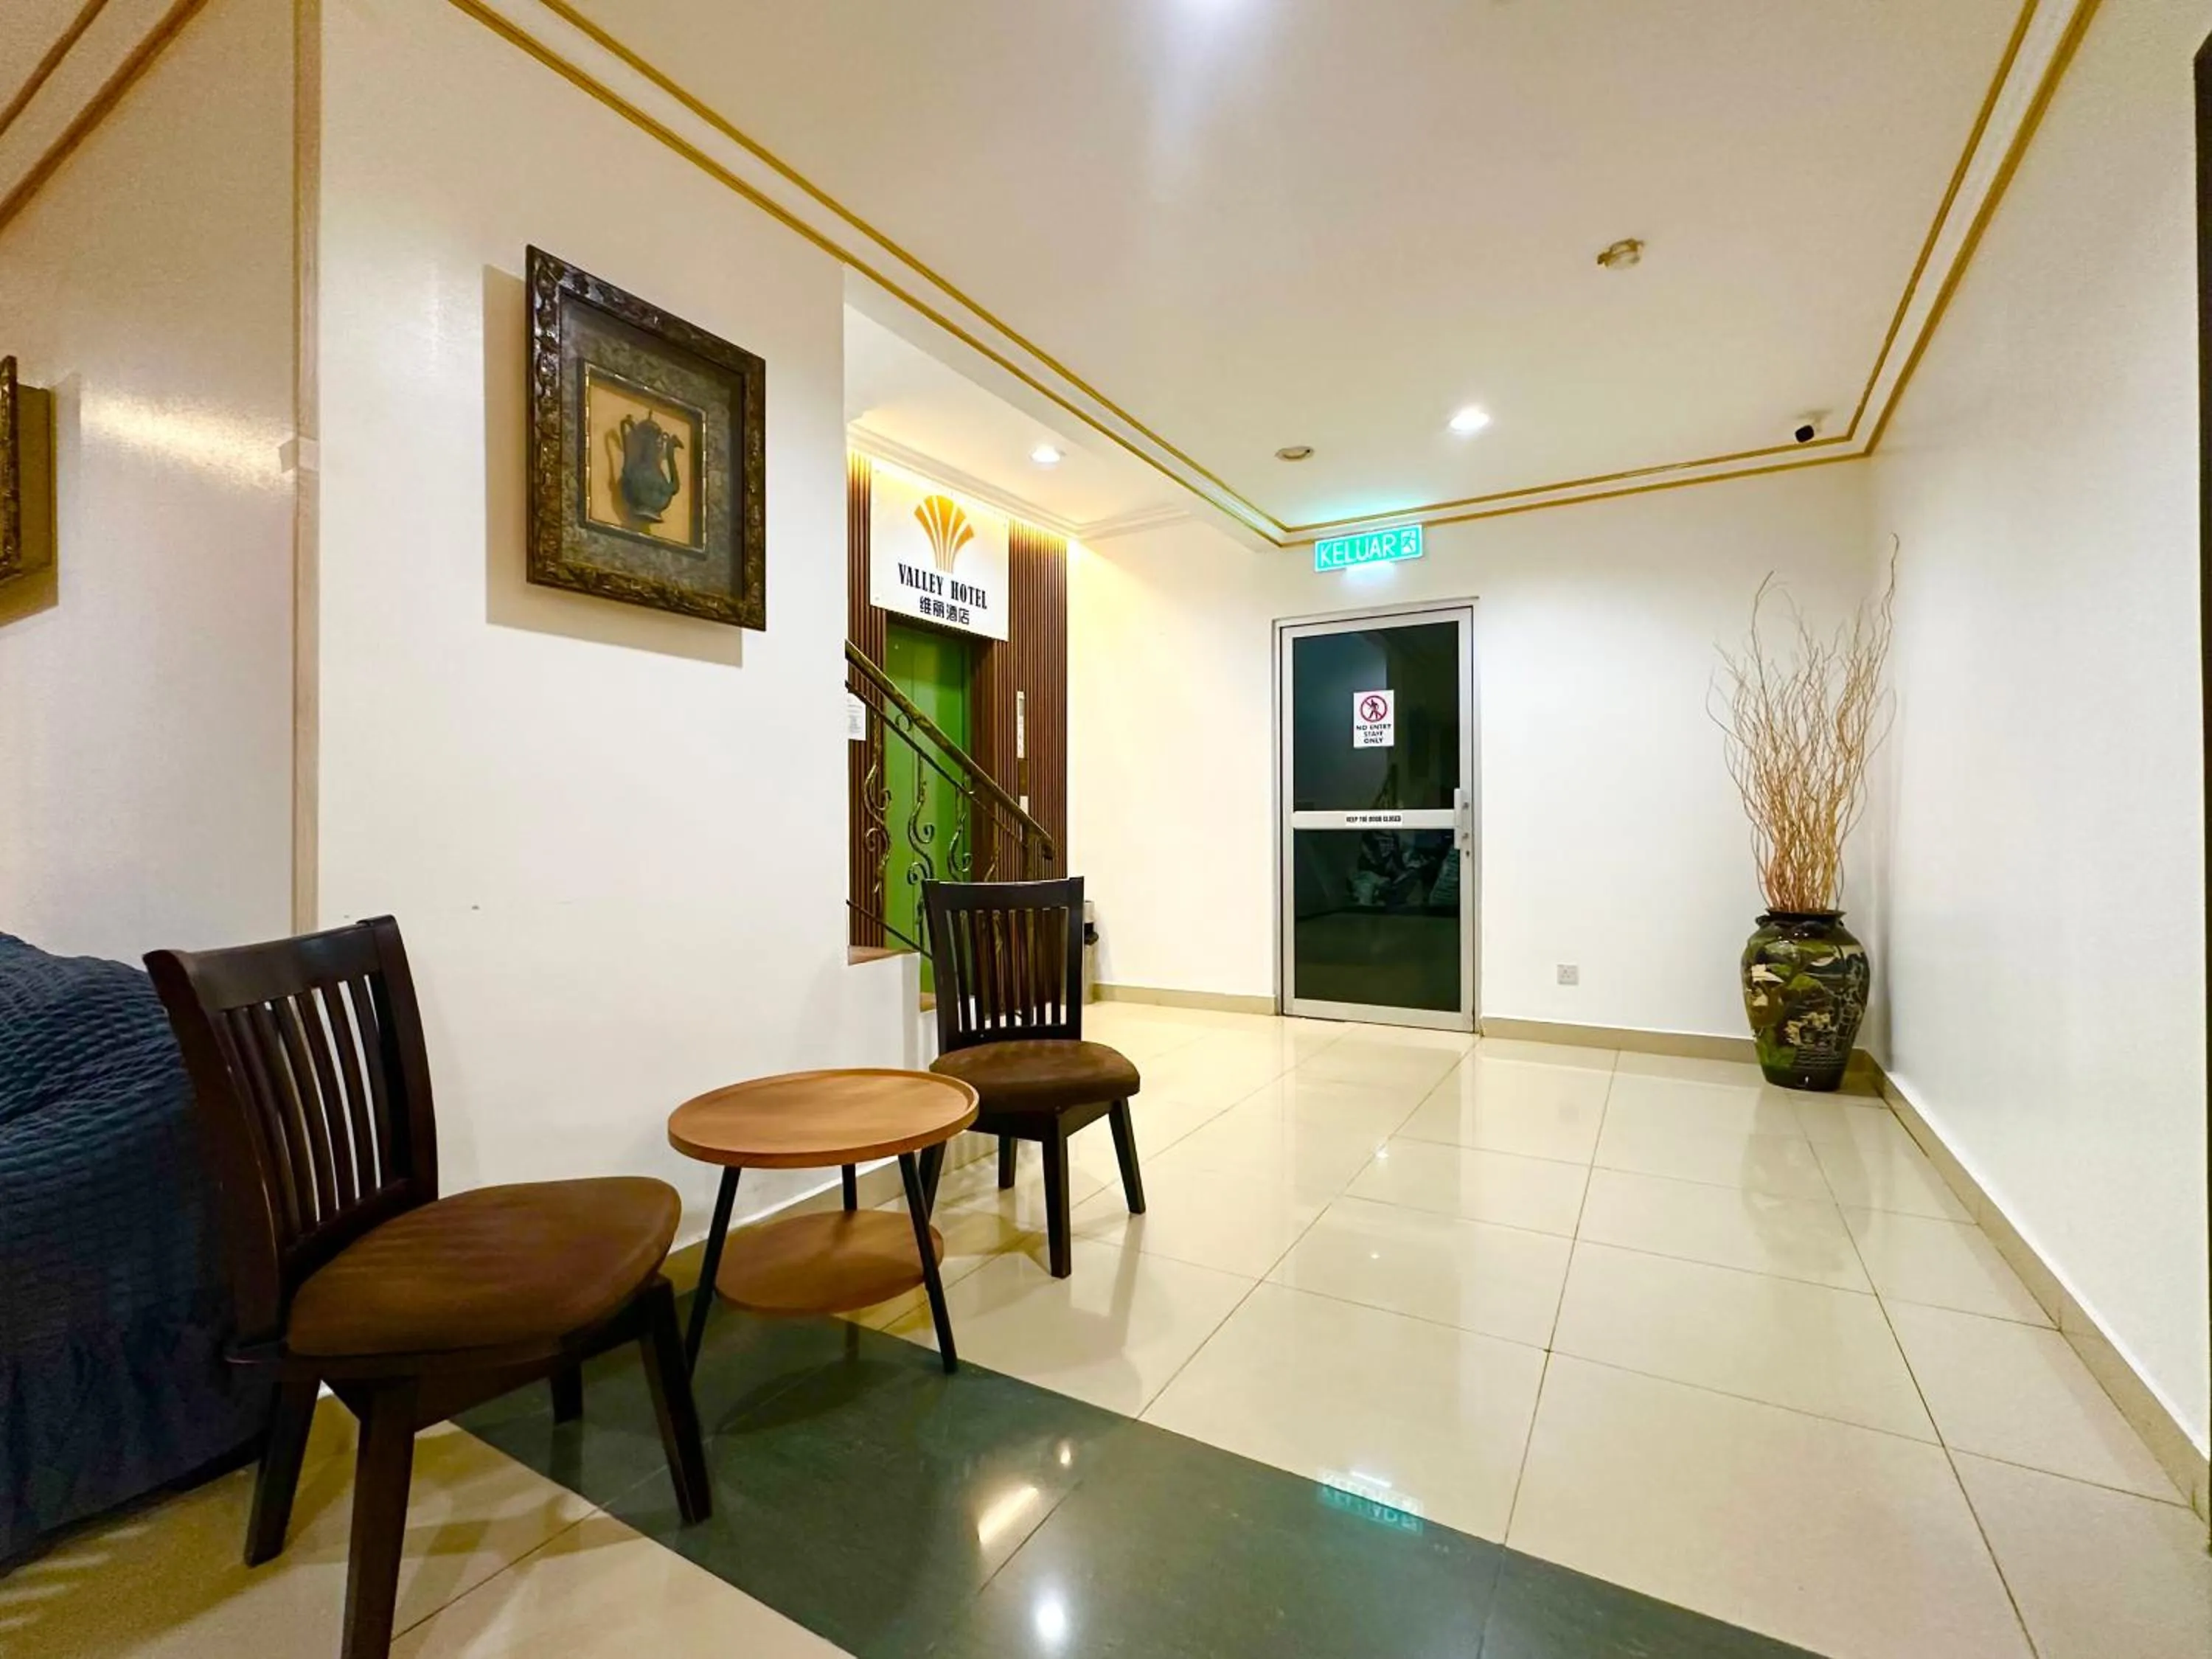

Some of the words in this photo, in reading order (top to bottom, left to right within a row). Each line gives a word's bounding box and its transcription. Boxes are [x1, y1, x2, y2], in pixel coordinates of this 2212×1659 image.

[1320, 534, 1397, 567] KELUAR
[897, 563, 943, 595] VALLEY
[950, 580, 987, 610] HOTEL
[919, 596, 970, 625] 维丽酒店
